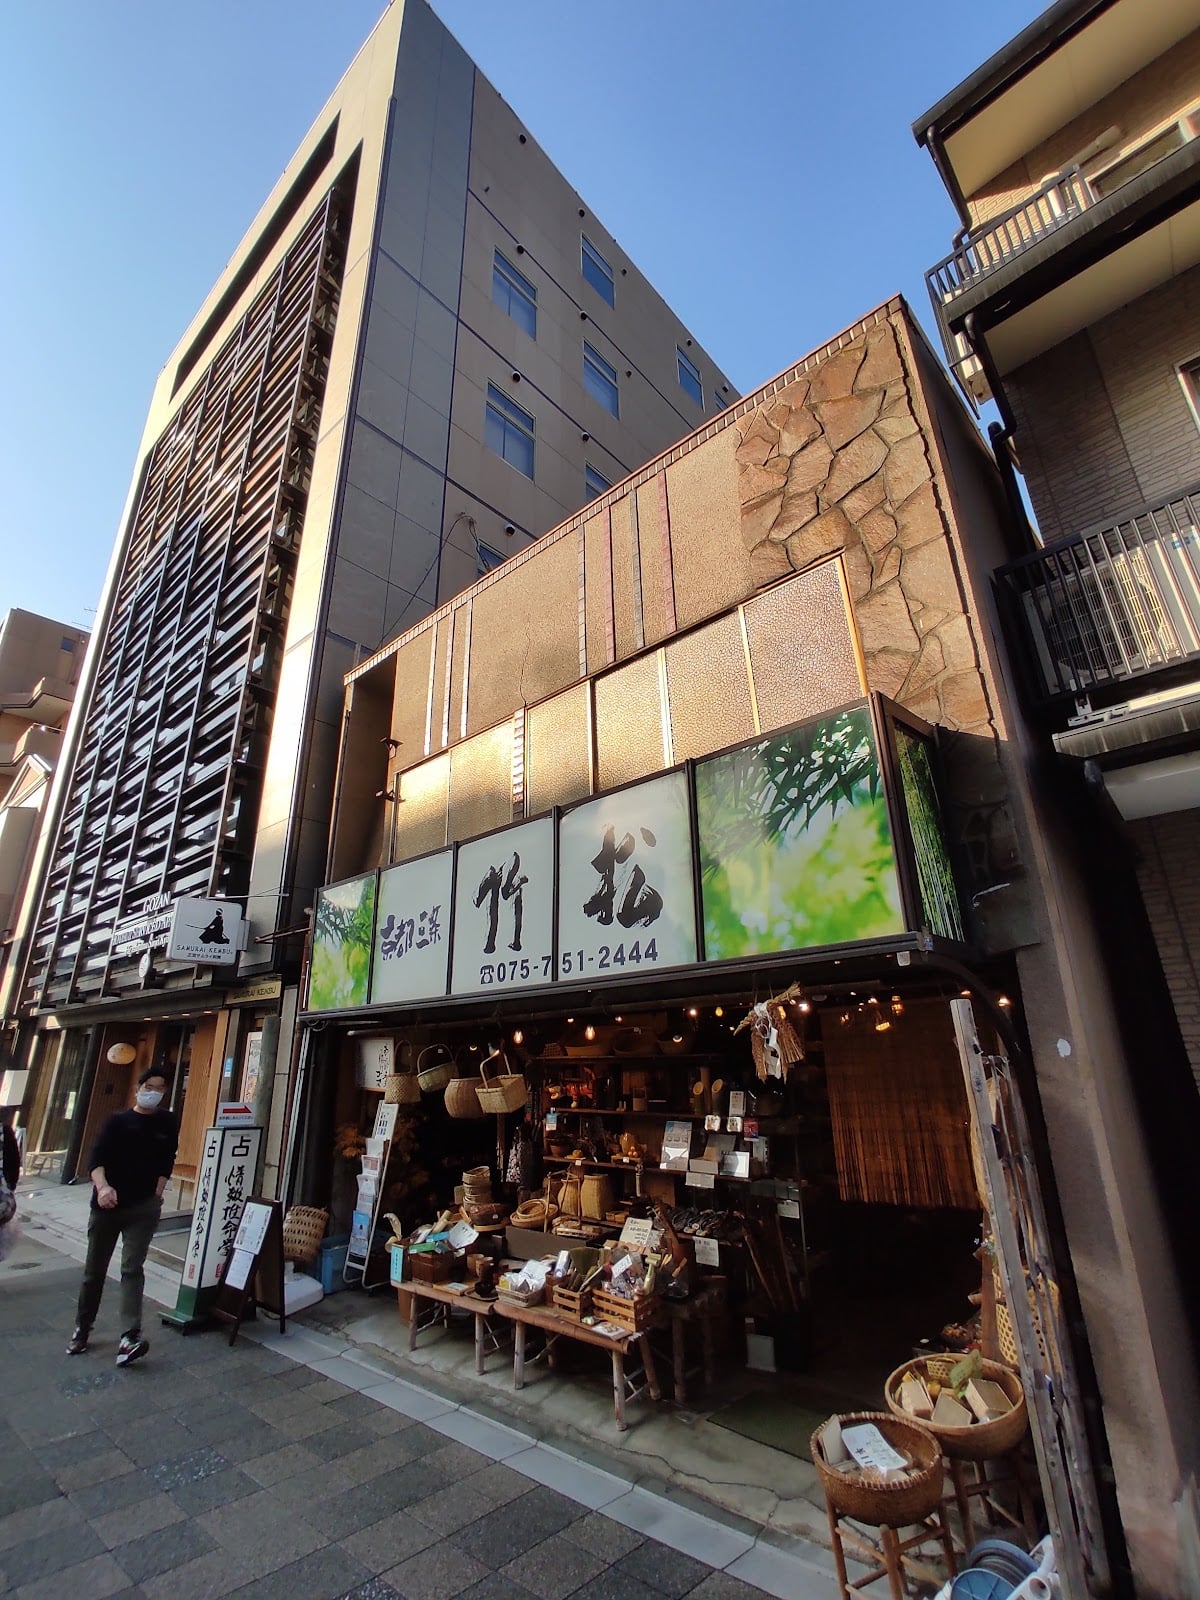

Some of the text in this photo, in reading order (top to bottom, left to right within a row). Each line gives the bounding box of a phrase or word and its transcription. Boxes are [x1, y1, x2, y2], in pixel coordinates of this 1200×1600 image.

[472, 823, 664, 954] 竹松
[143, 891, 171, 913] GOZAN
[176, 945, 206, 954] SAMURAI
[207, 1137, 217, 1158] 占
[231, 1136, 252, 1158] 占
